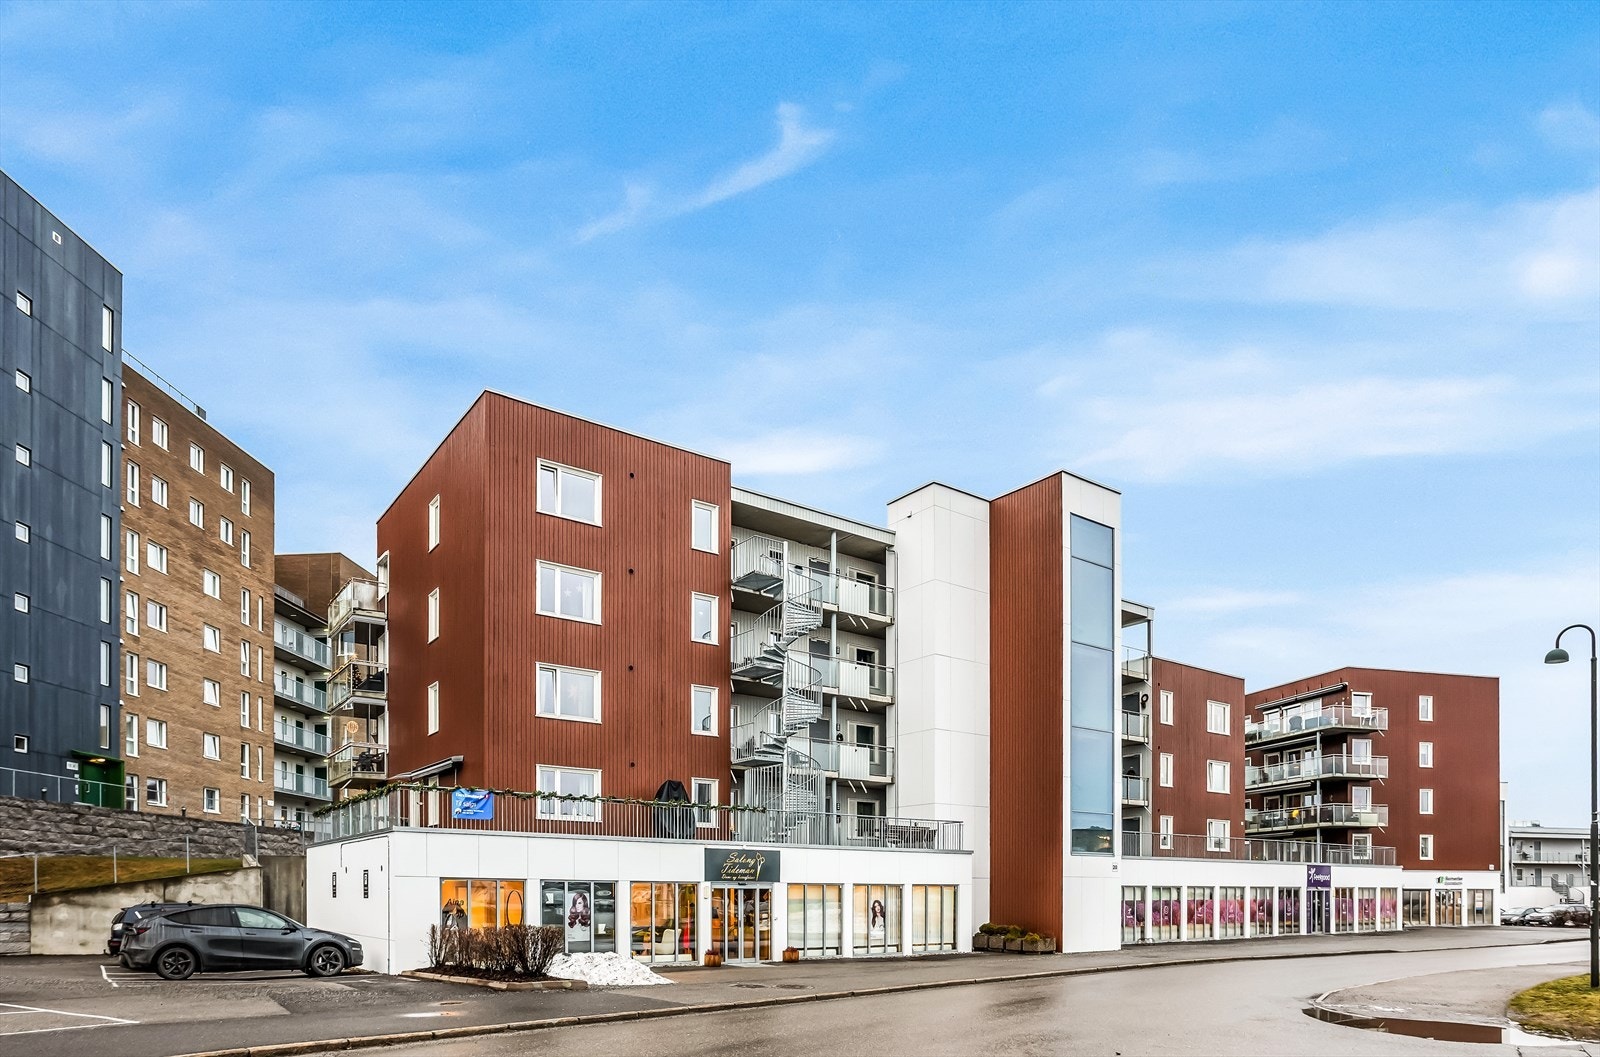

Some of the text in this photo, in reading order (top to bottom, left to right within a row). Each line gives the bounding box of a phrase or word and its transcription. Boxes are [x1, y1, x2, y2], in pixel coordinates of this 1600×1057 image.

[726, 852, 756, 867] Salong
[721, 863, 755, 873] Tideman
[1313, 873, 1331, 883] Feelgood
